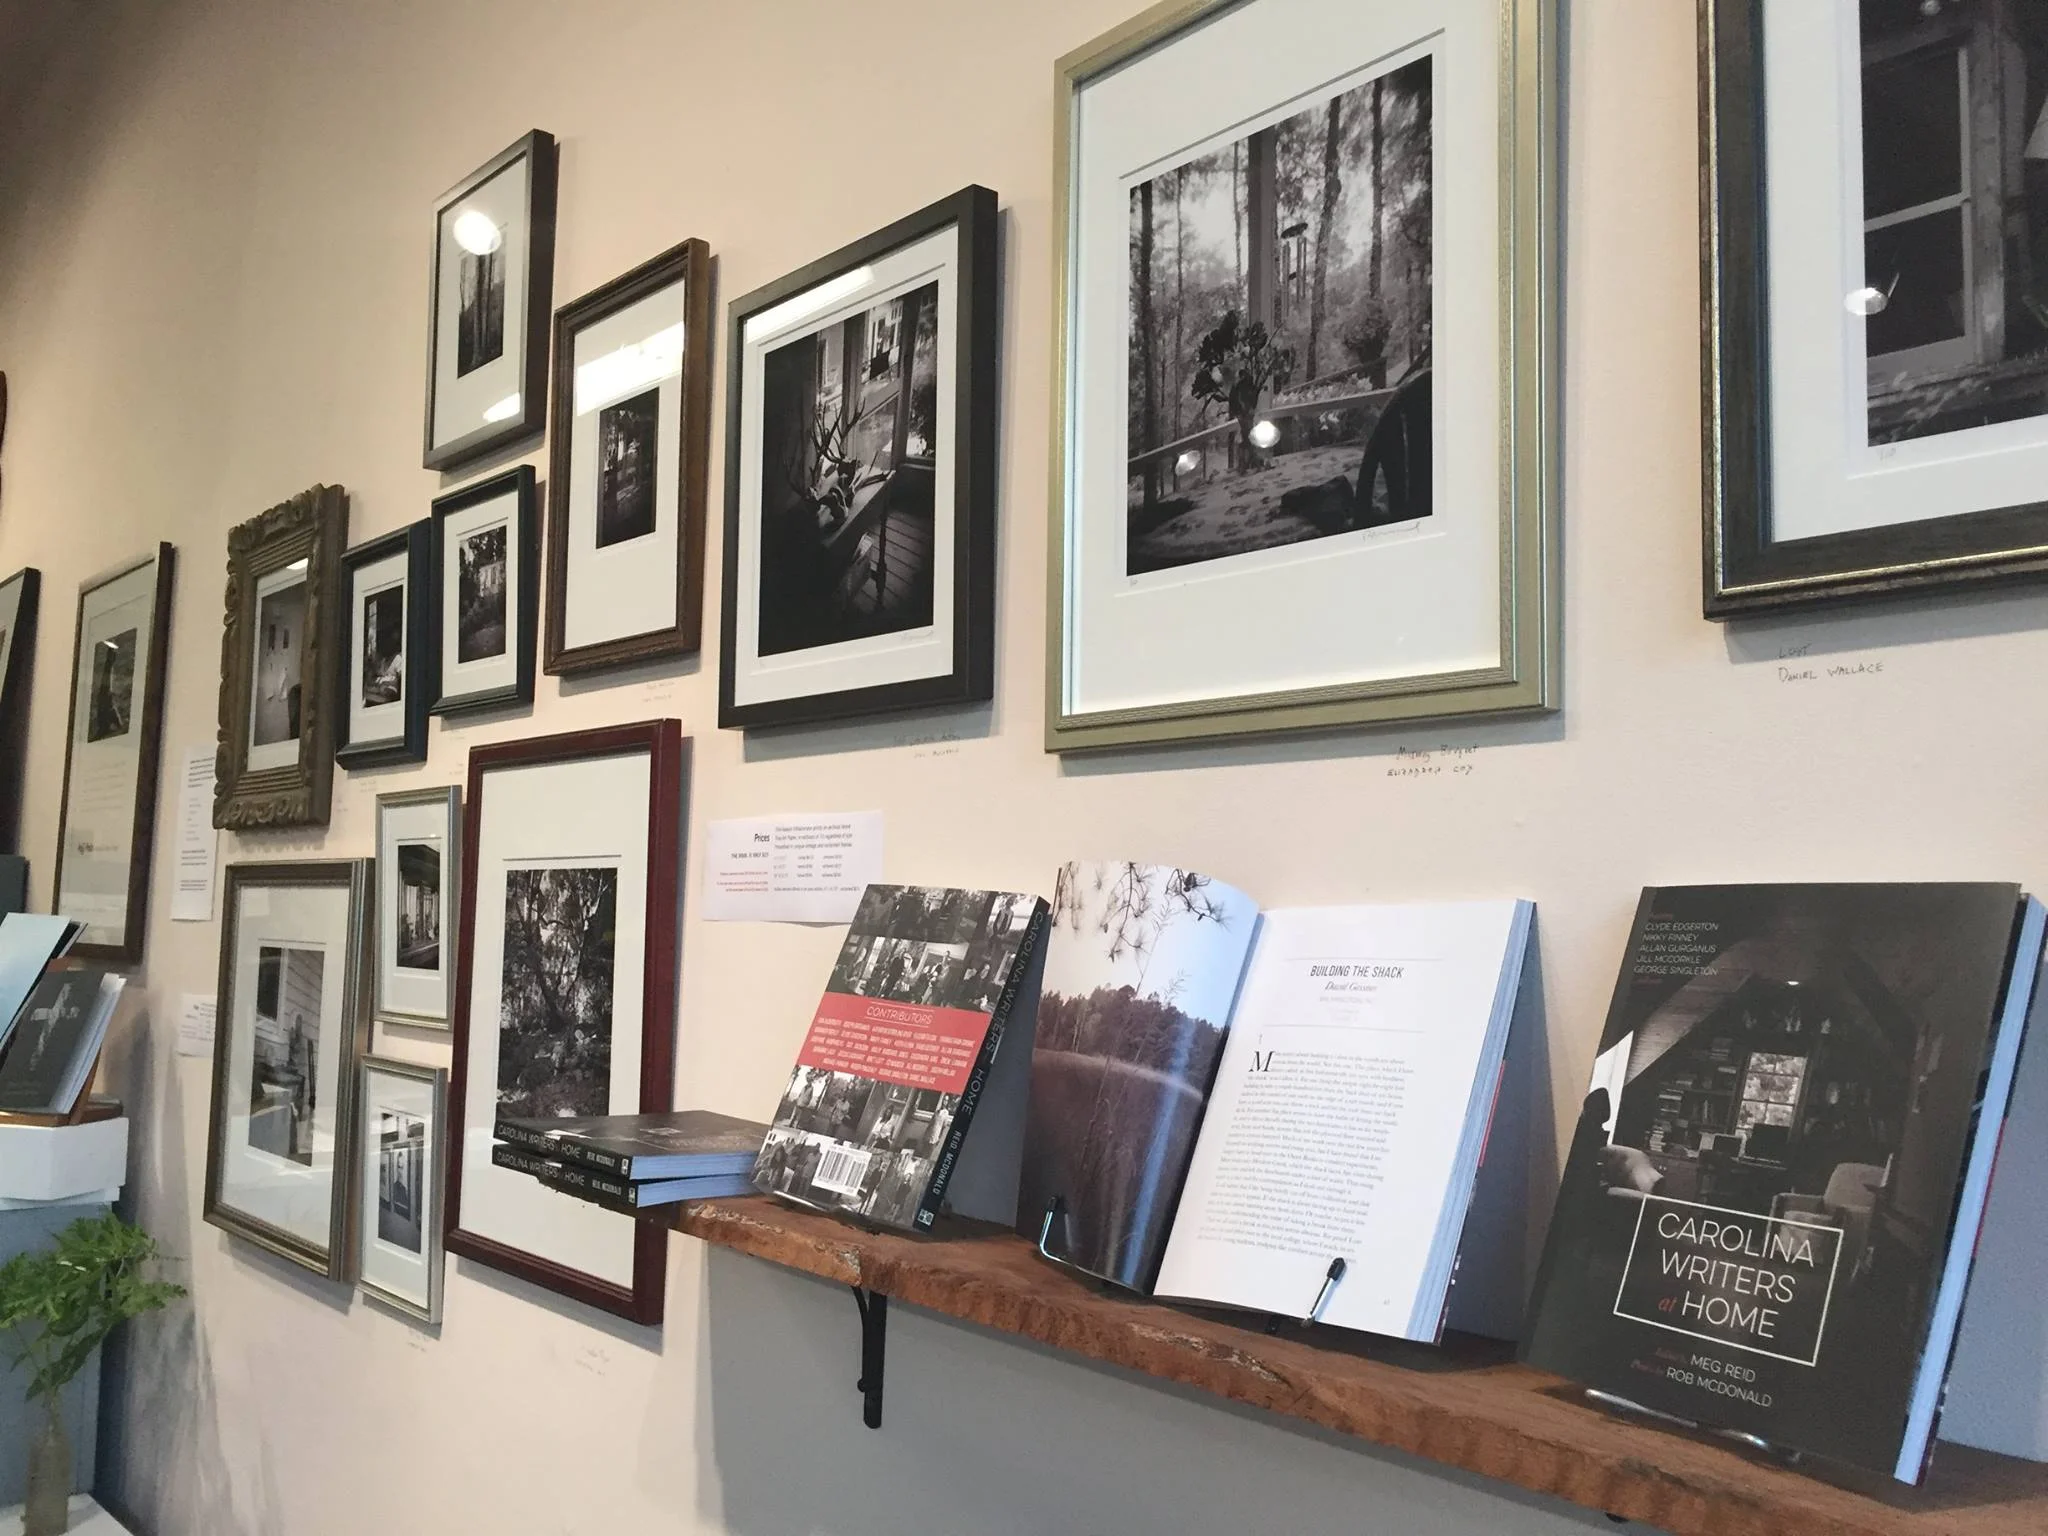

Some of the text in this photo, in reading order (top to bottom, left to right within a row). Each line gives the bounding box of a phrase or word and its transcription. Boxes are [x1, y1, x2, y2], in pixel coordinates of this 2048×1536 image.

[1827, 662, 1884, 677] WALLACE
[753, 833, 771, 843] Prices
[1645, 922, 1719, 932] CLYDE EDGERTON
[1639, 944, 1716, 953] ALLAN GURGANUS
[1310, 965, 1405, 979] BUILDING THE SHACK
[1633, 965, 1719, 976] GEORGE SINGLETON
[866, 1005, 934, 1025] CONTRIBUTORS
[961, 911, 1044, 1115] CAROLINA WRITERS HOME
[497, 1124, 528, 1145] CAROLINA
[528, 1135, 555, 1151] WRITERS
[561, 1143, 582, 1160] HOME
[496, 1151, 529, 1169] CAROLINA
[529, 1161, 558, 1179] WRITERS
[564, 1171, 586, 1187] HOME
[932, 1130, 962, 1196] REID MCDONALD
[1657, 1212, 1814, 1268] CAROLINA
[1662, 1248, 1797, 1303] WRITERS
[1657, 1290, 1780, 1339] at HOME
[1690, 1353, 1722, 1374] MEG
[1724, 1363, 1756, 1383] REID
[1666, 1366, 1694, 1385] ROB
[1696, 1376, 1773, 1408] MCDONALD
